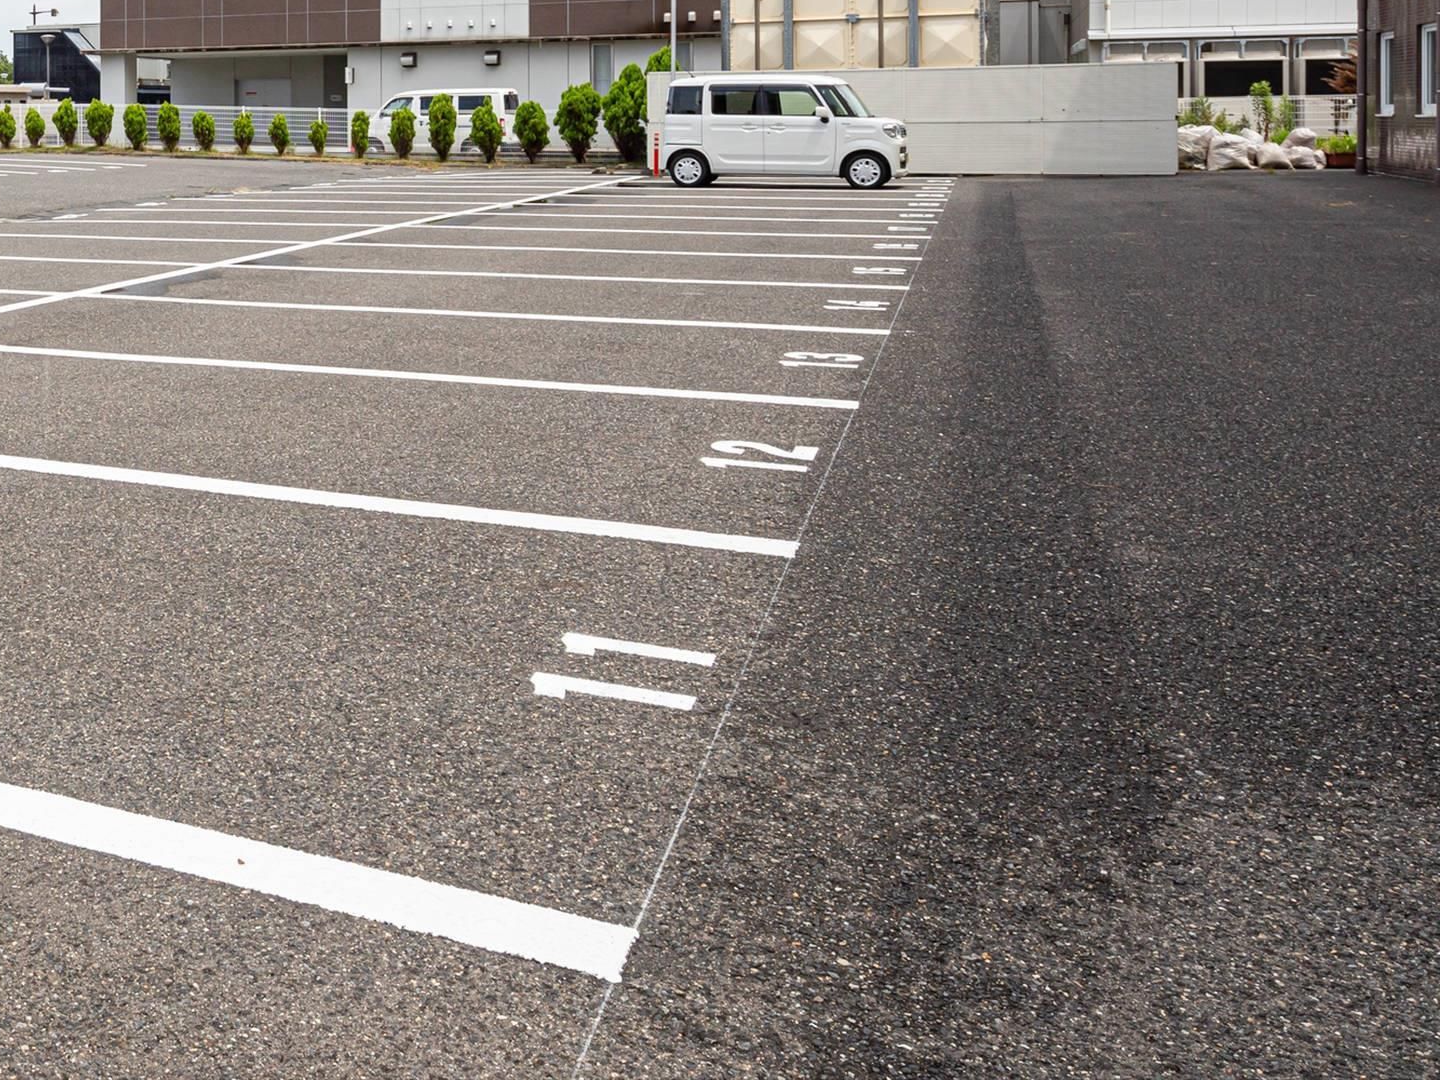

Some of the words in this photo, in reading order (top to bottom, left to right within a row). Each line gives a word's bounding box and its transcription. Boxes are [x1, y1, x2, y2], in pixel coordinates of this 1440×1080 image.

[779, 351, 865, 369] 13
[700, 440, 819, 473] 12
[530, 632, 717, 712] 11
